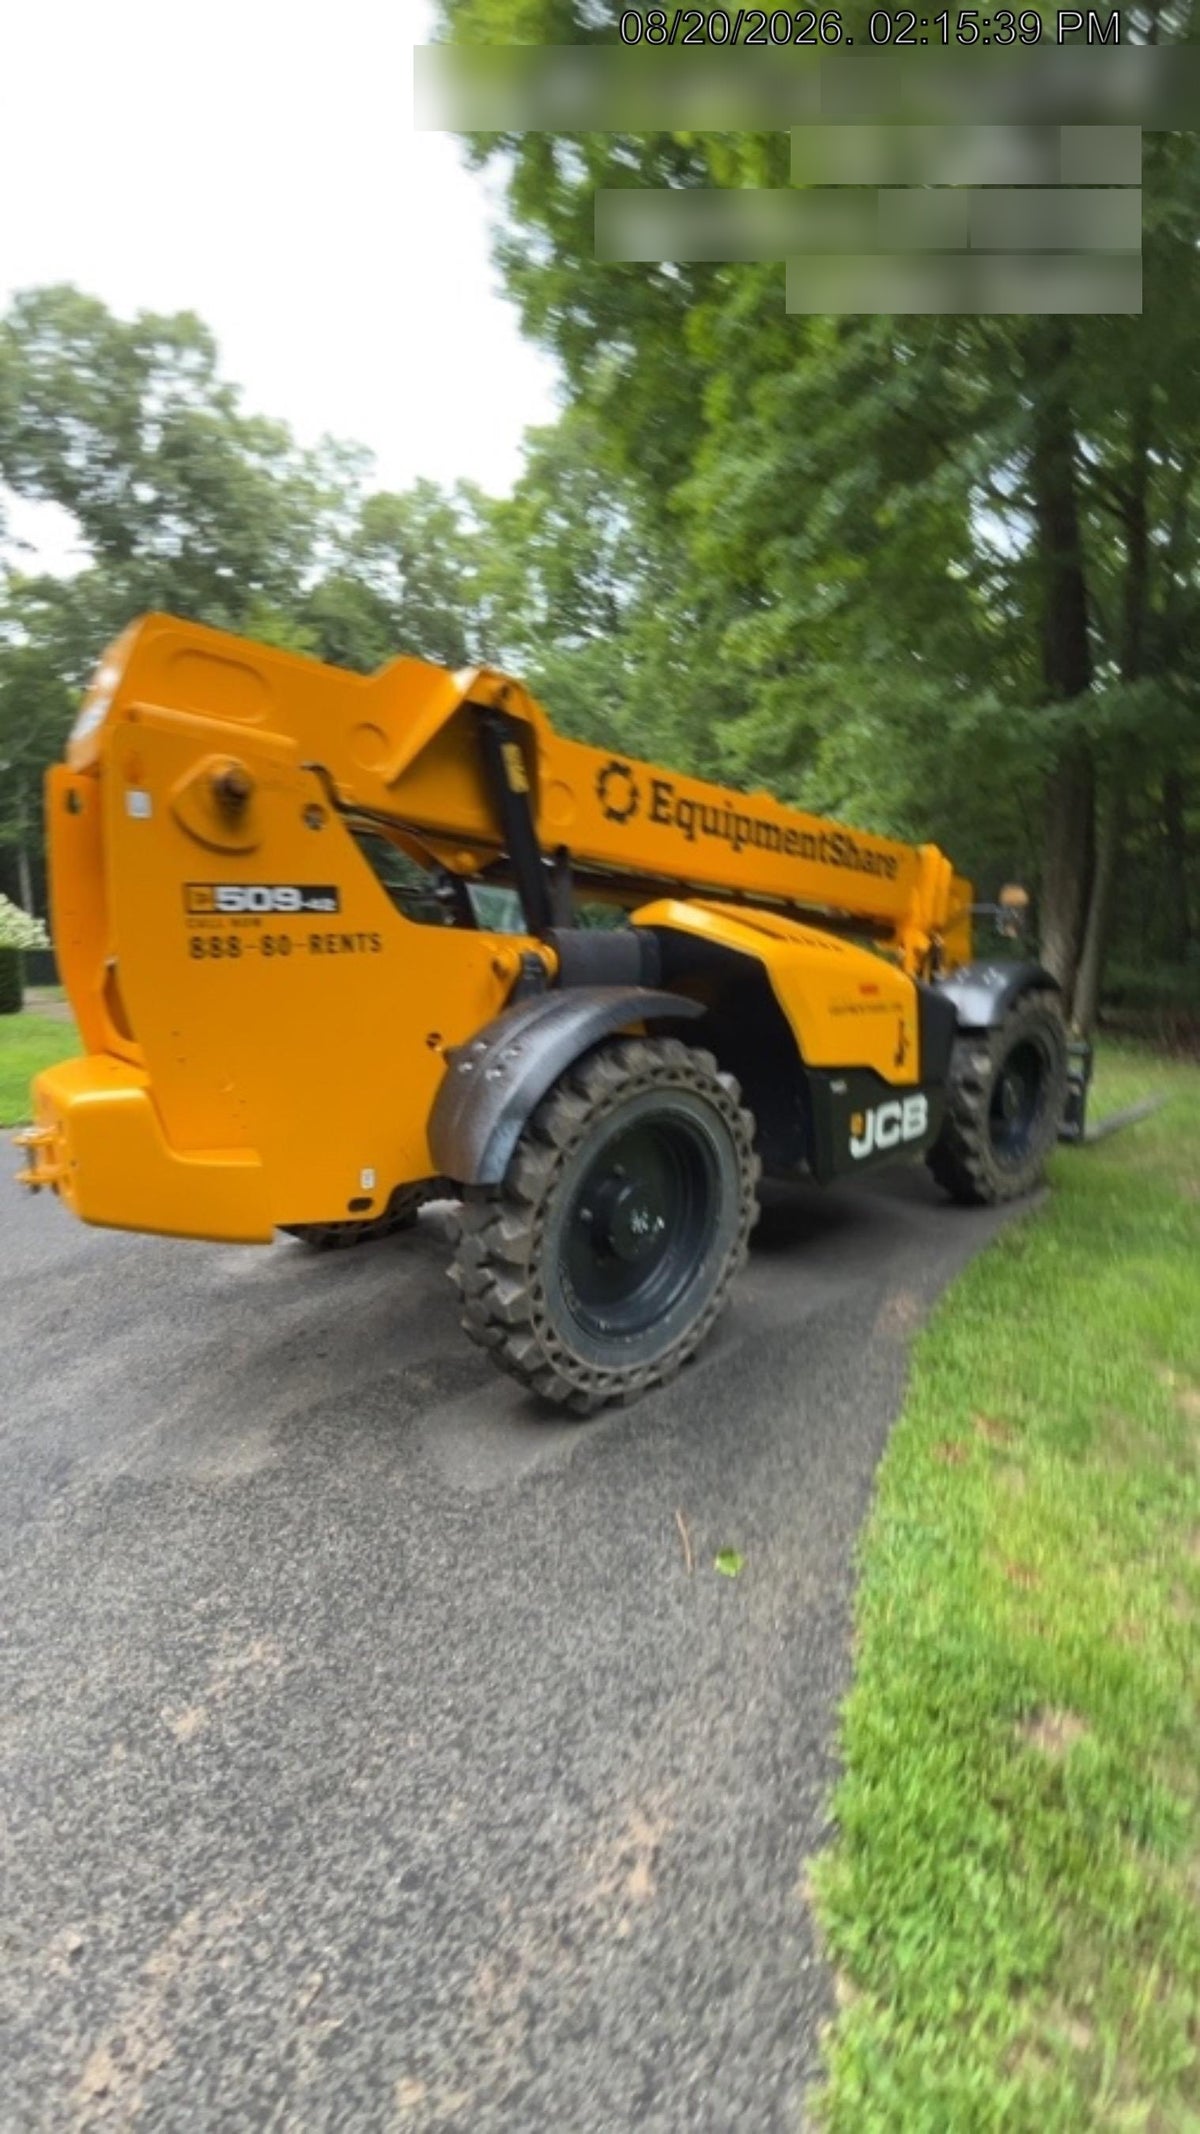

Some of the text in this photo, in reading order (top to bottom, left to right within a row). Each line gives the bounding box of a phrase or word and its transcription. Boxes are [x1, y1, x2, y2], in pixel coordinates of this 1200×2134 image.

[649, 778, 898, 880] EquipmentShare
[190, 932, 382, 959] 888-80-RENTS
[850, 1093, 928, 1159] JCB
